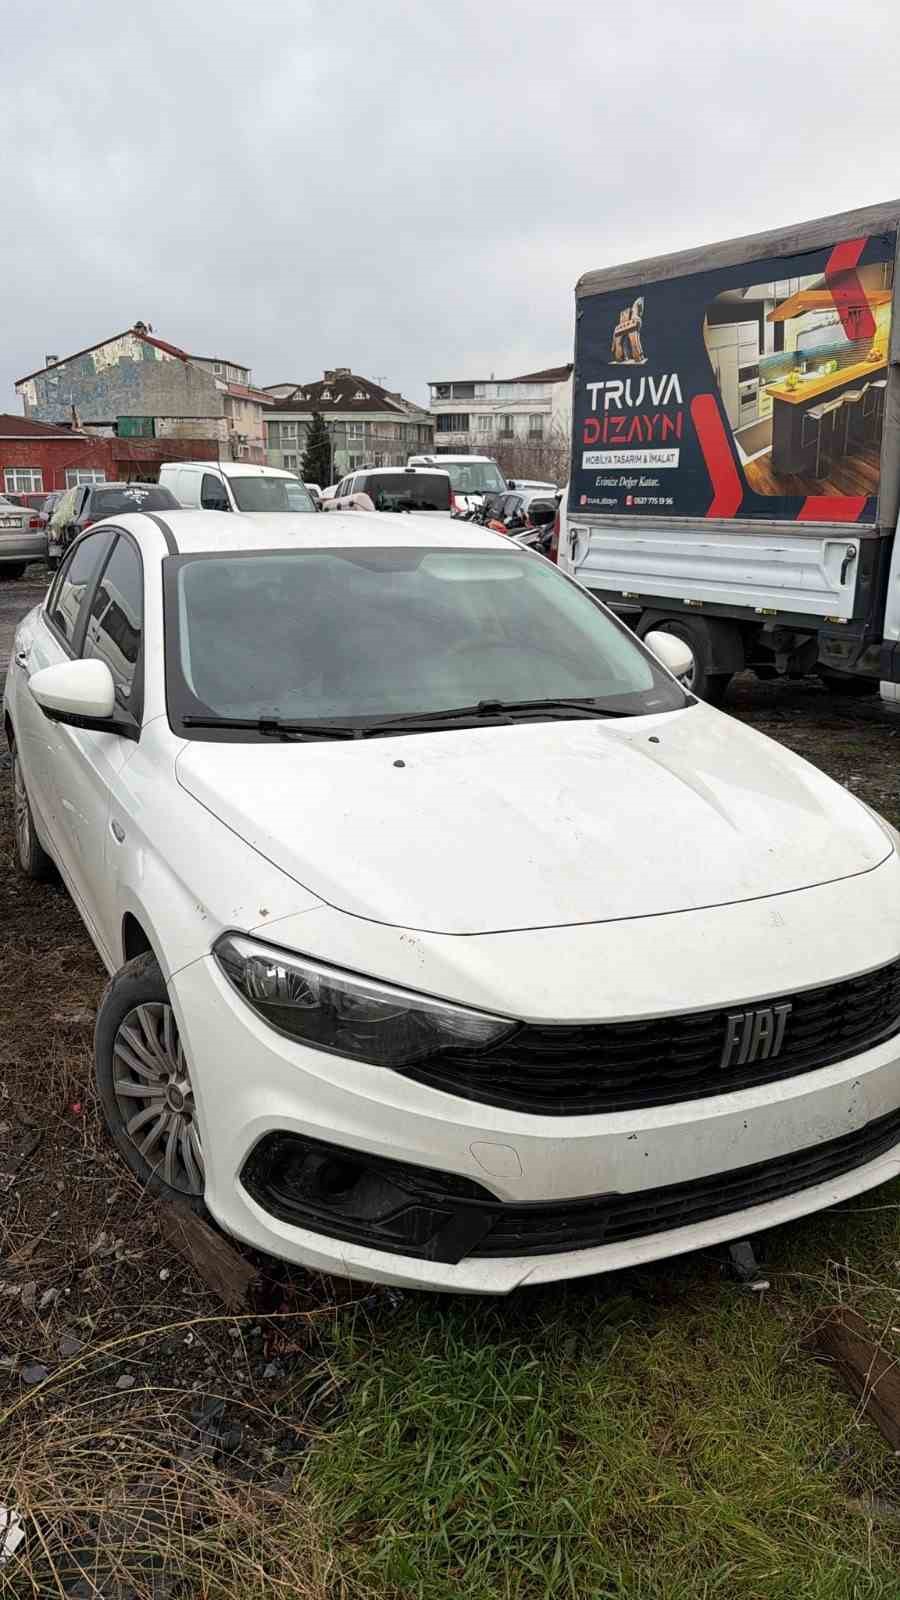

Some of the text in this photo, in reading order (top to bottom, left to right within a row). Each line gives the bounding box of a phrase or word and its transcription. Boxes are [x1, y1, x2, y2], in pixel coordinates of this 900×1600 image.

[586, 373, 683, 411] TRUVA
[583, 409, 684, 444] DİZAYN
[613, 454, 642, 465] TASARIM
[720, 1003, 792, 1069] FIAT
